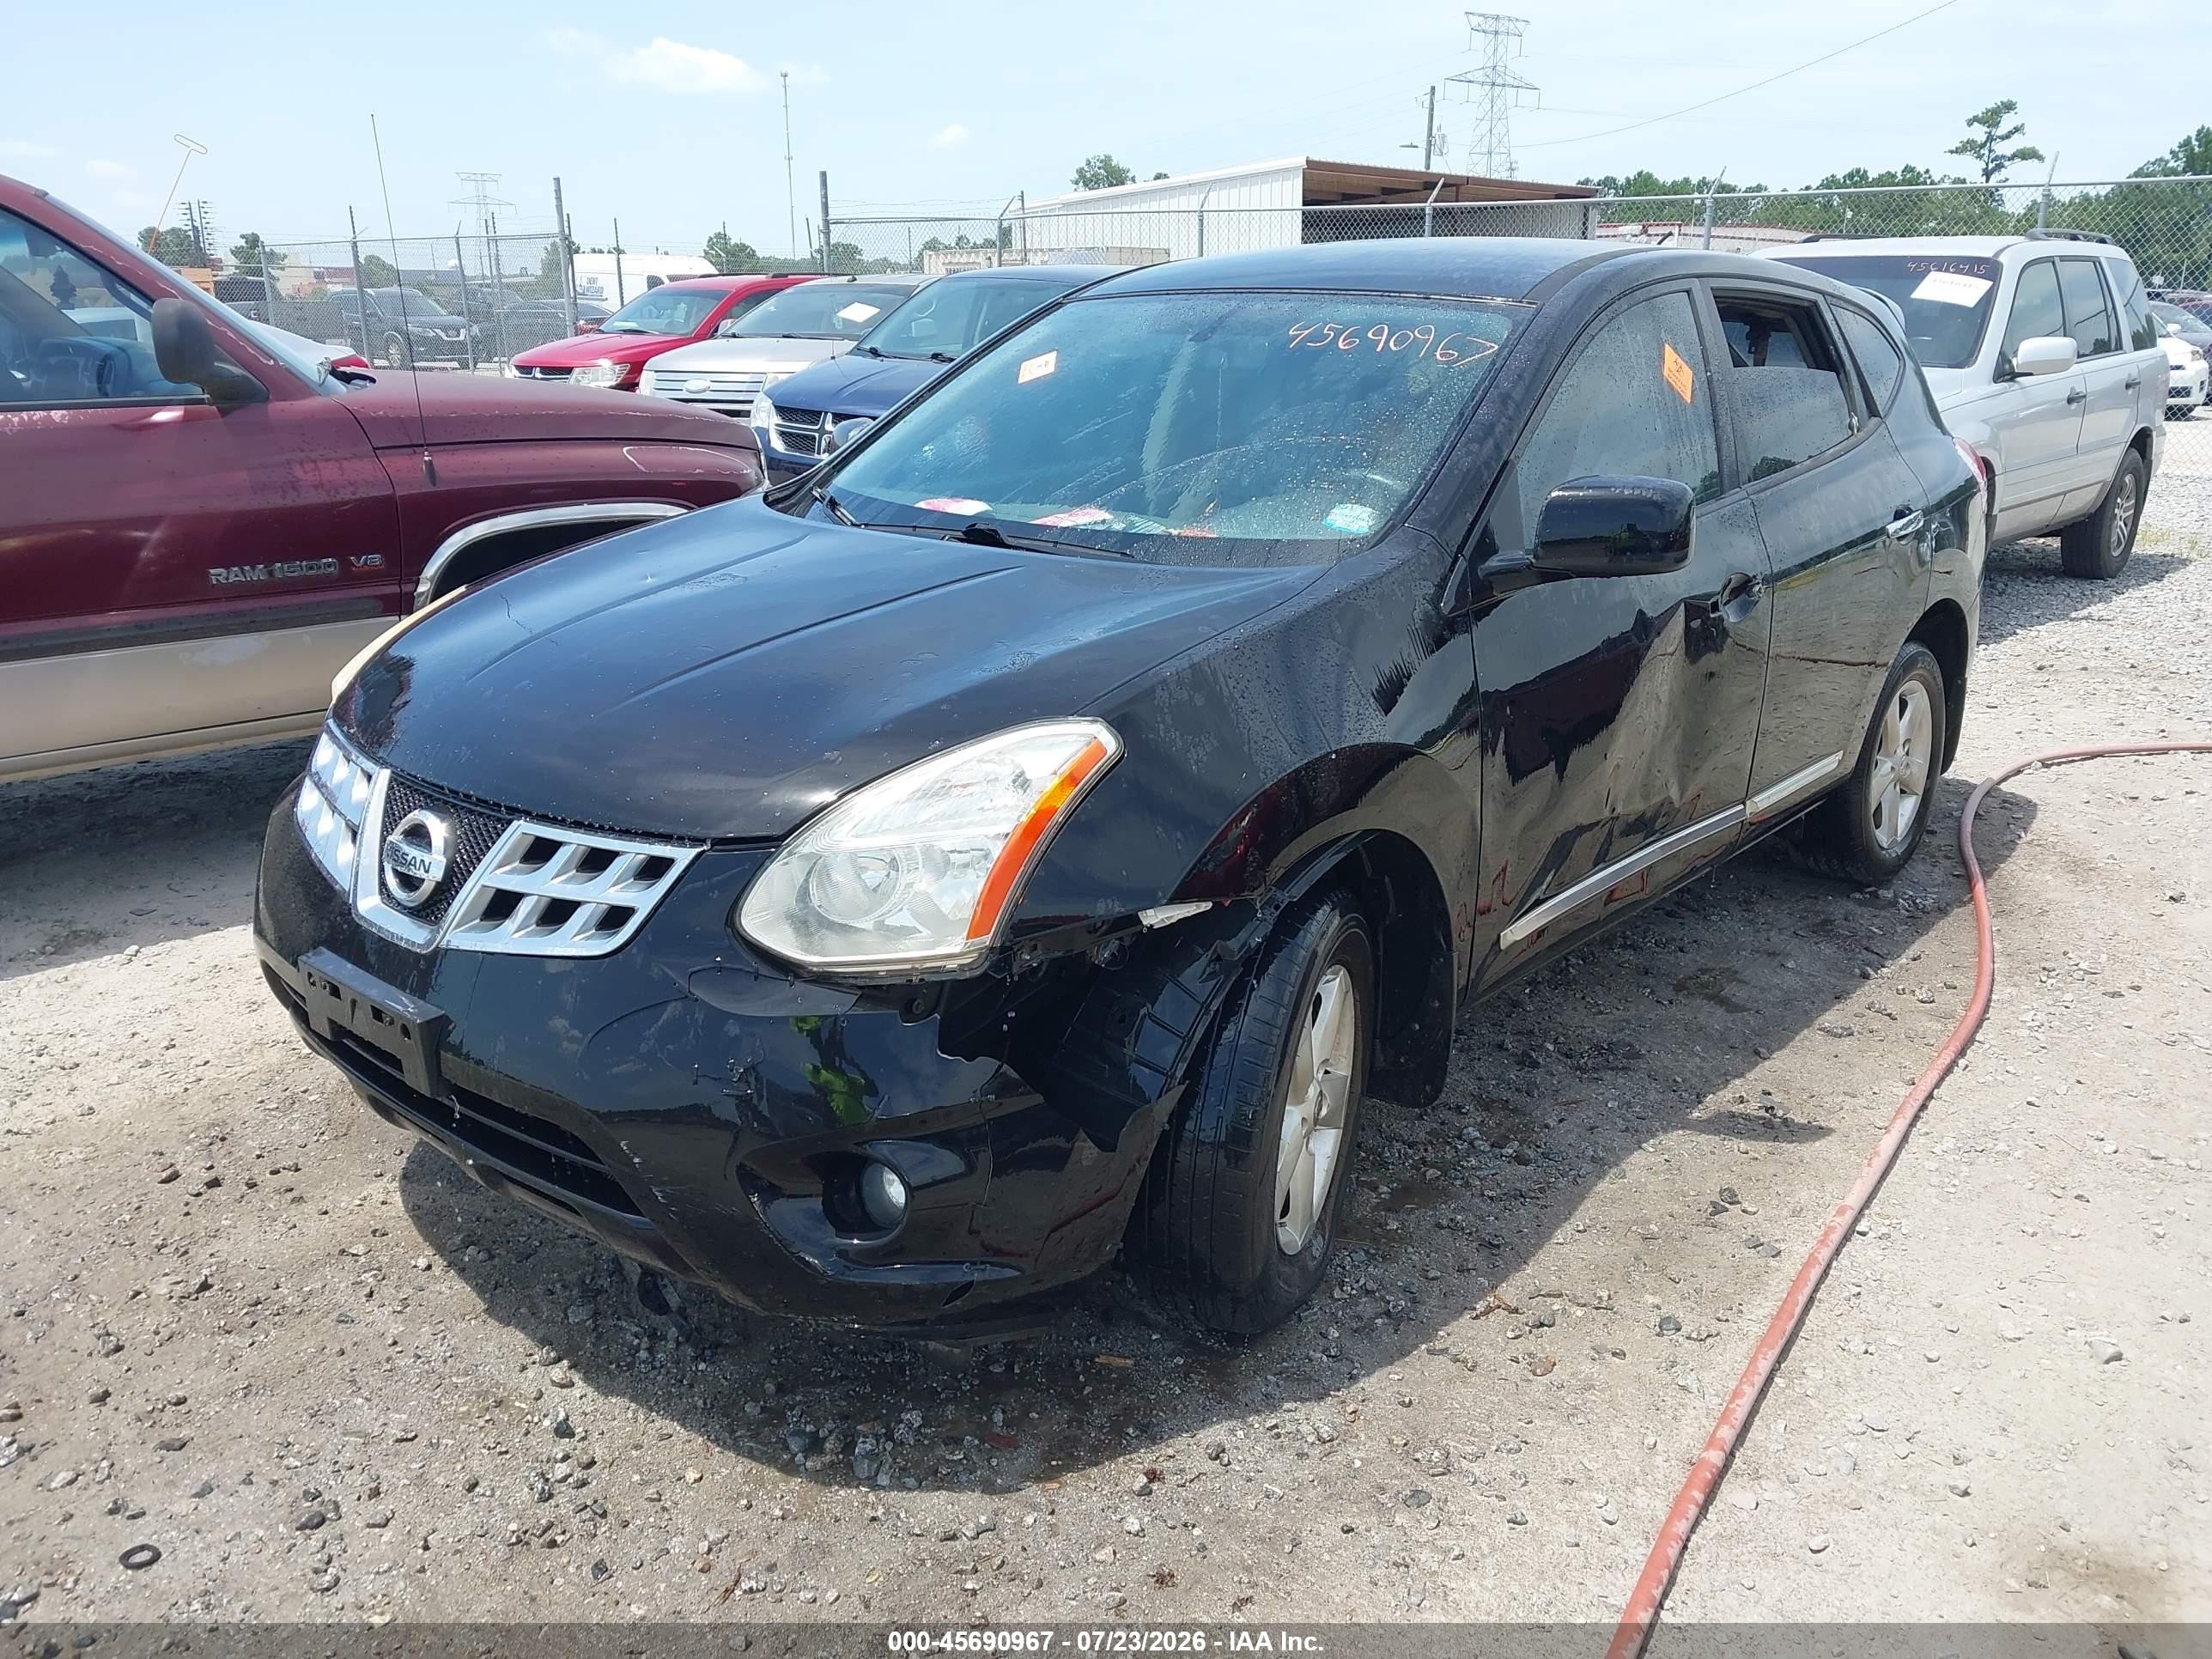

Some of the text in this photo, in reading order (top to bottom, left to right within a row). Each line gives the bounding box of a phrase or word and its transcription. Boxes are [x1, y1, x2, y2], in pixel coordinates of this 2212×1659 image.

[1289, 321, 1499, 367] 45690967
[208, 554, 385, 585] RAM 1500 V8
[384, 841, 432, 874] NISSAN
